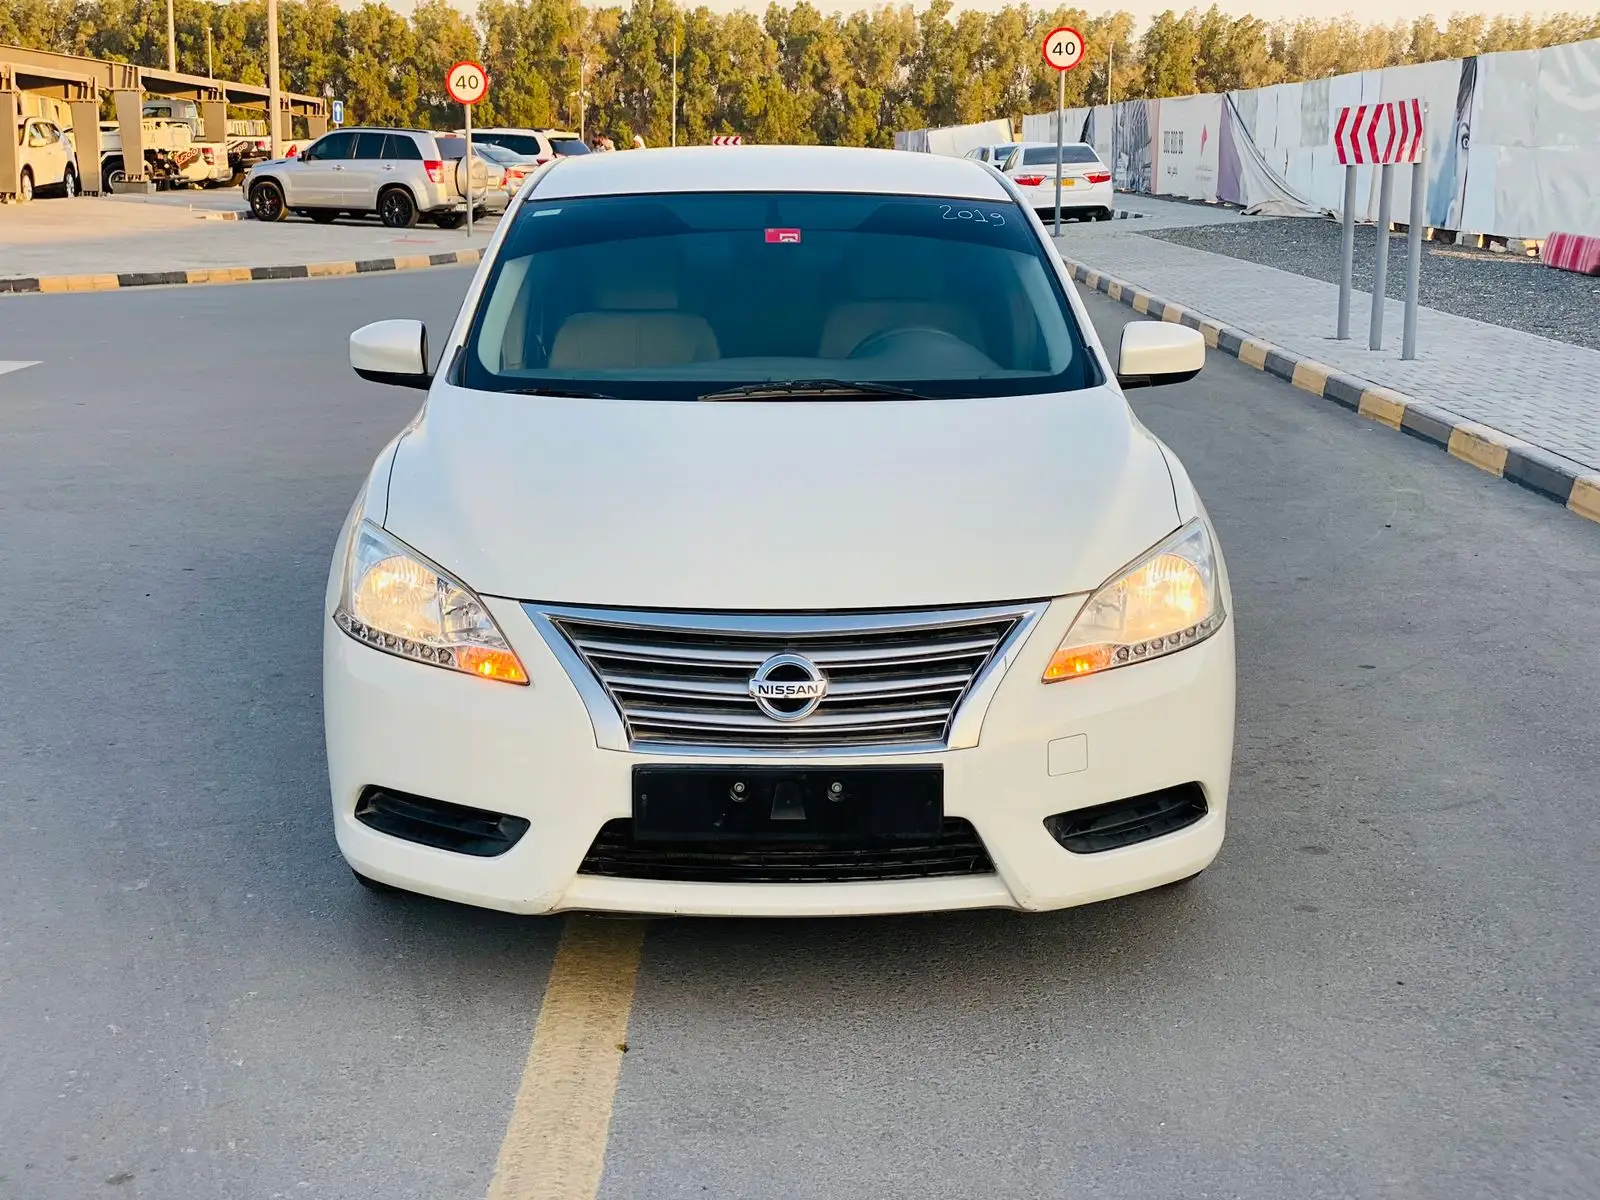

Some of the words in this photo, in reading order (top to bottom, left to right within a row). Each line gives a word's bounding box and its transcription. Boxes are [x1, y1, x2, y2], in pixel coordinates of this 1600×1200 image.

[1052, 41, 1076, 56] 40
[455, 75, 479, 89] 40
[939, 204, 1006, 227] 2019
[758, 684, 818, 695] NISSAN
